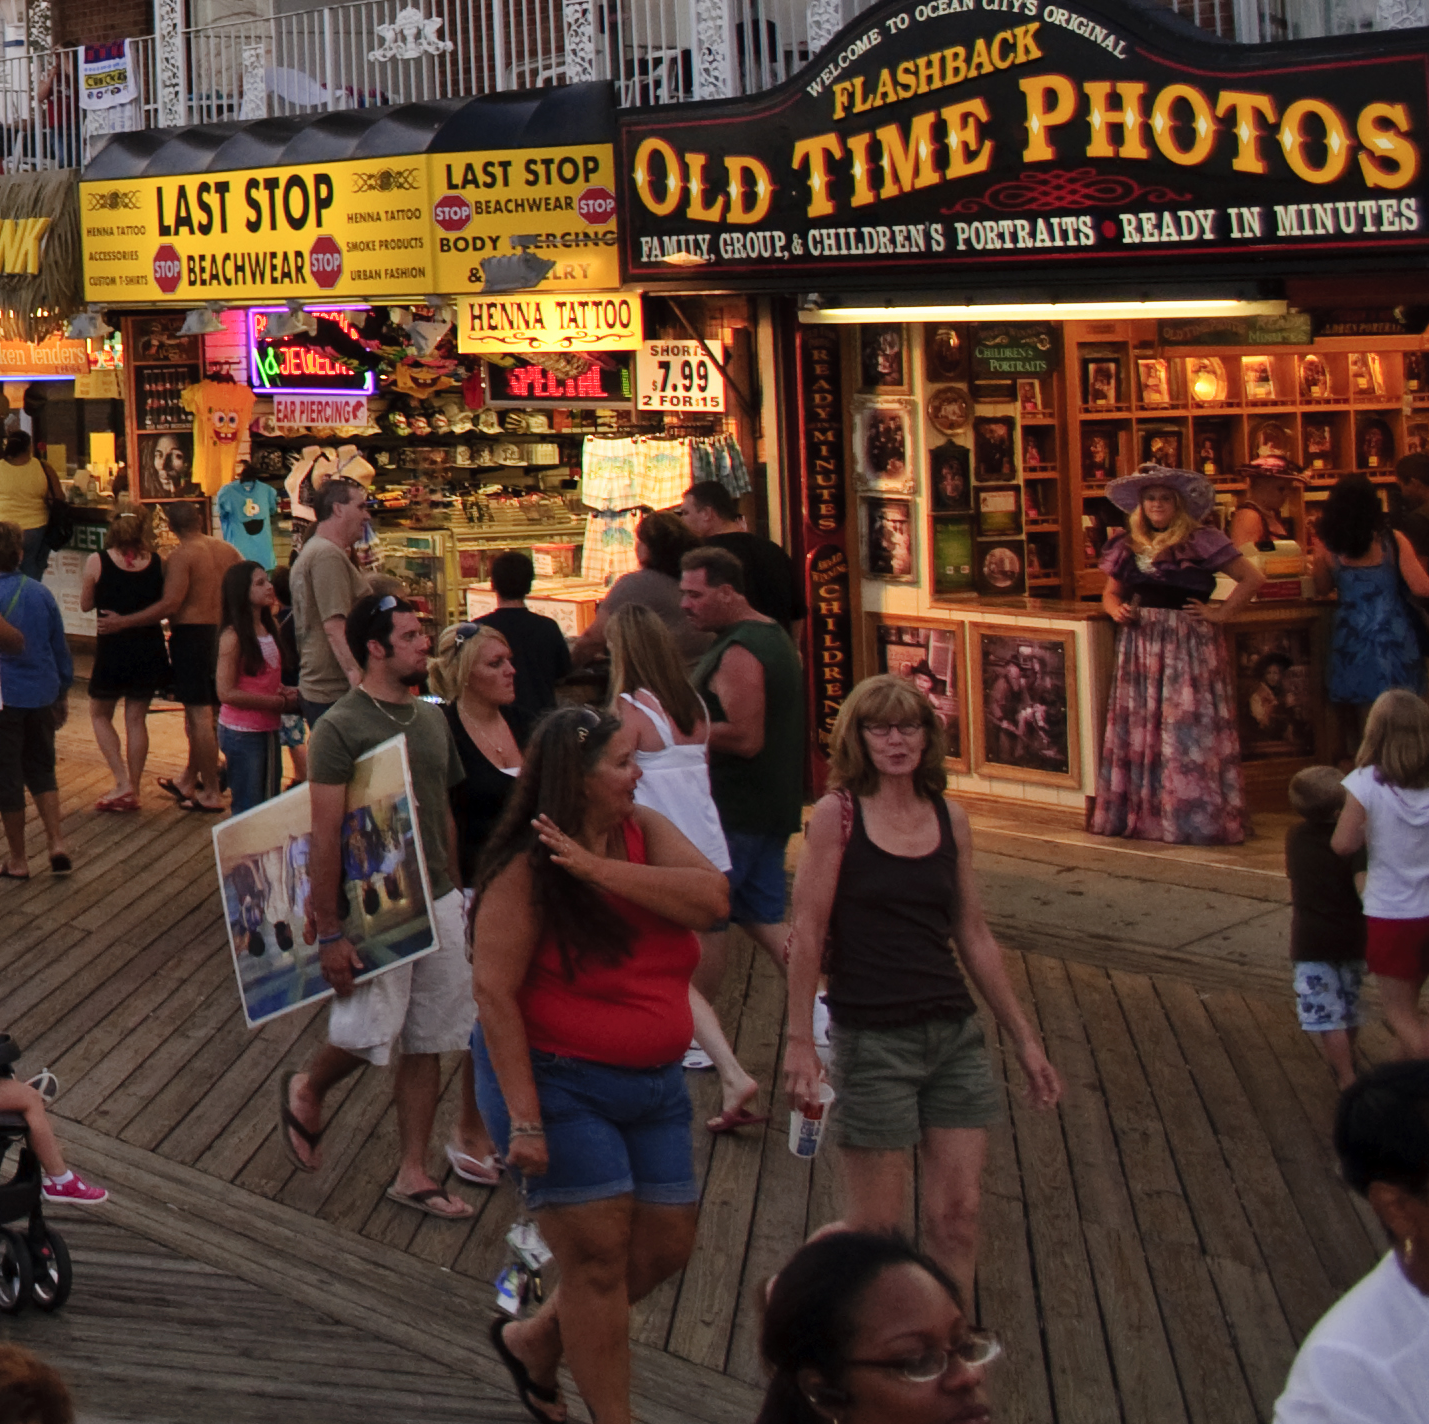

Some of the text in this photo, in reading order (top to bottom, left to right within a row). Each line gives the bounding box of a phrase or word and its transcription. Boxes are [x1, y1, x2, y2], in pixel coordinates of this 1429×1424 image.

[806, 28, 882, 98] WELCOME
[885, 13, 910, 35] TO
[1043, 5, 1128, 59] ORIGINAL
[832, 22, 1043, 120] FLASHBACK
[633, 75, 1421, 225] OLD TIME PHOTOS
[446, 156, 600, 190] LAST STOP
[157, 173, 335, 237] LAST STOP
[347, 208, 422, 224] HENNA TATTOO
[436, 196, 615, 221] STOP BEACHWEAR STOP
[87, 225, 146, 237] HENNA TATTOO
[1119, 198, 1419, 243] READY IN MINUTES
[346, 237, 424, 253] SMOKE PRODUCTS
[440, 235, 500, 253] BODY
[640, 214, 1096, 263] FAMILY, GROUP, & CHILDREN'S PORTRAITS
[89, 250, 139, 261] ACCESSORIES
[154, 250, 341, 287] STOP BEACHWEAR STOP
[89, 274, 148, 286] CUSTOM T-SHIRTS
[350, 267, 426, 281] URBAN FASHION
[468, 268, 482, 283] &
[469, 299, 631, 331] HENNA TATTOO
[265, 347, 280, 375] &
[975, 346, 1034, 358] CHILDREN'S
[652, 360, 708, 393] $7.99
[989, 359, 1047, 372] PORTRAITS
[812, 349, 835, 419] READY
[276, 401, 351, 423] EAR PIERCING
[643, 396, 652, 406] 2
[659, 396, 693, 407] FOR
[813, 431, 838, 530] MINUTES
